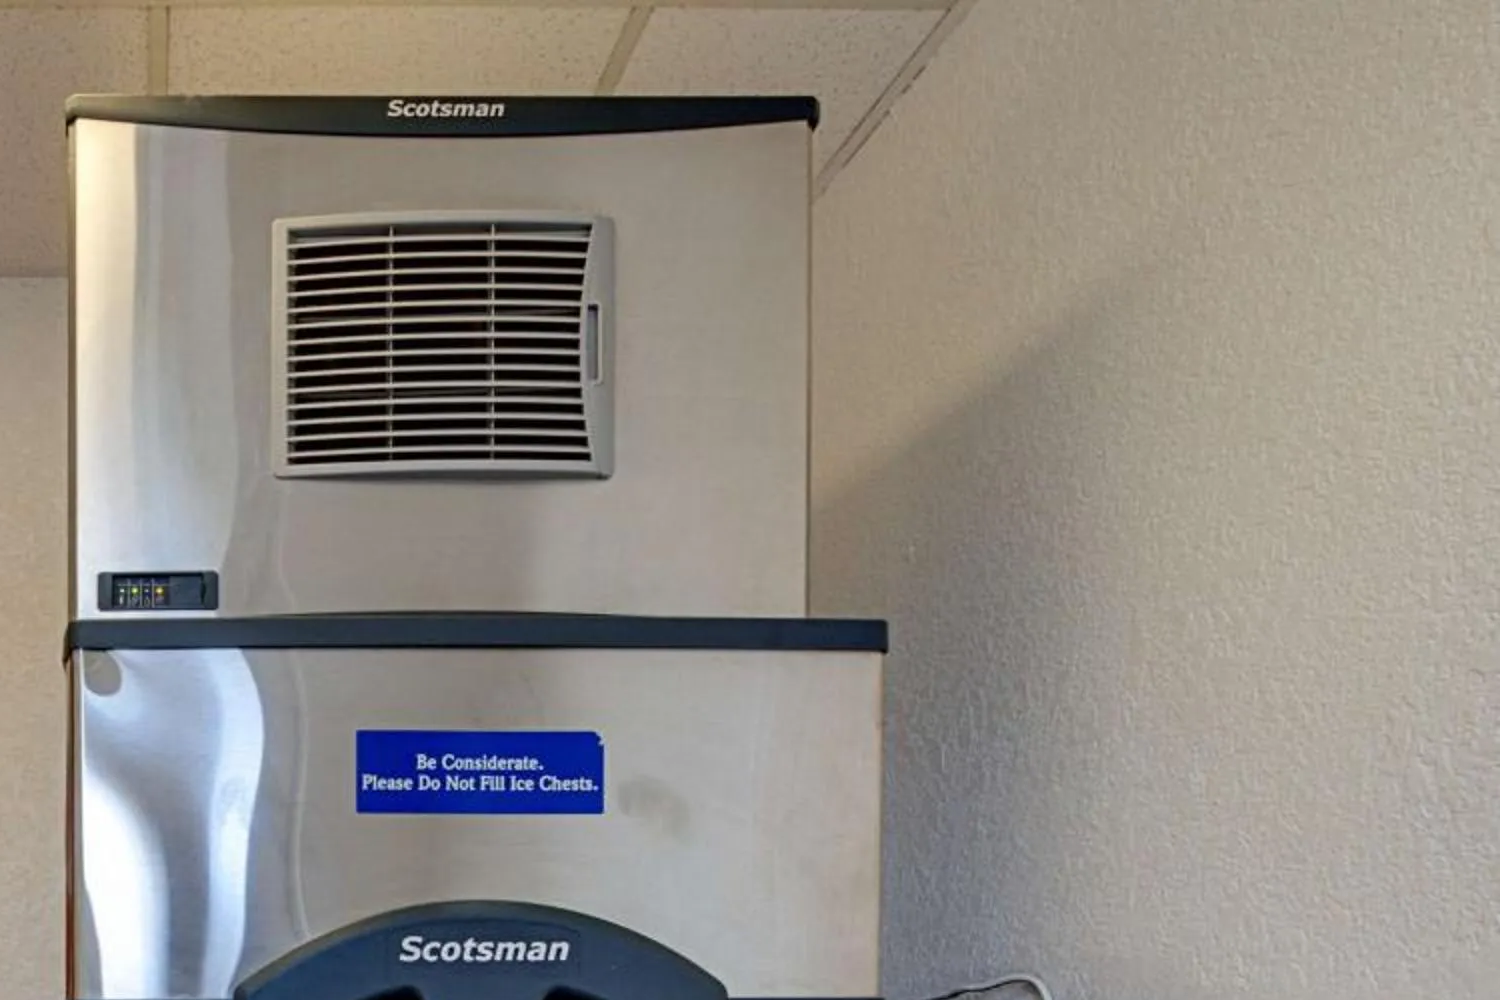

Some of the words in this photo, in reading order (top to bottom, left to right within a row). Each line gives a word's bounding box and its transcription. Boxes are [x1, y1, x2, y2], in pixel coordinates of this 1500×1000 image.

[387, 99, 505, 117] Scotsman
[416, 754, 437, 770] Be
[442, 753, 544, 771] Considerate.
[362, 773, 413, 791] Please
[418, 775, 441, 791] Do
[446, 775, 475, 791] Not
[480, 775, 506, 791] Fill
[511, 776, 535, 791] Ice
[539, 775, 599, 791] Chests.
[400, 936, 569, 962] Scotsman
